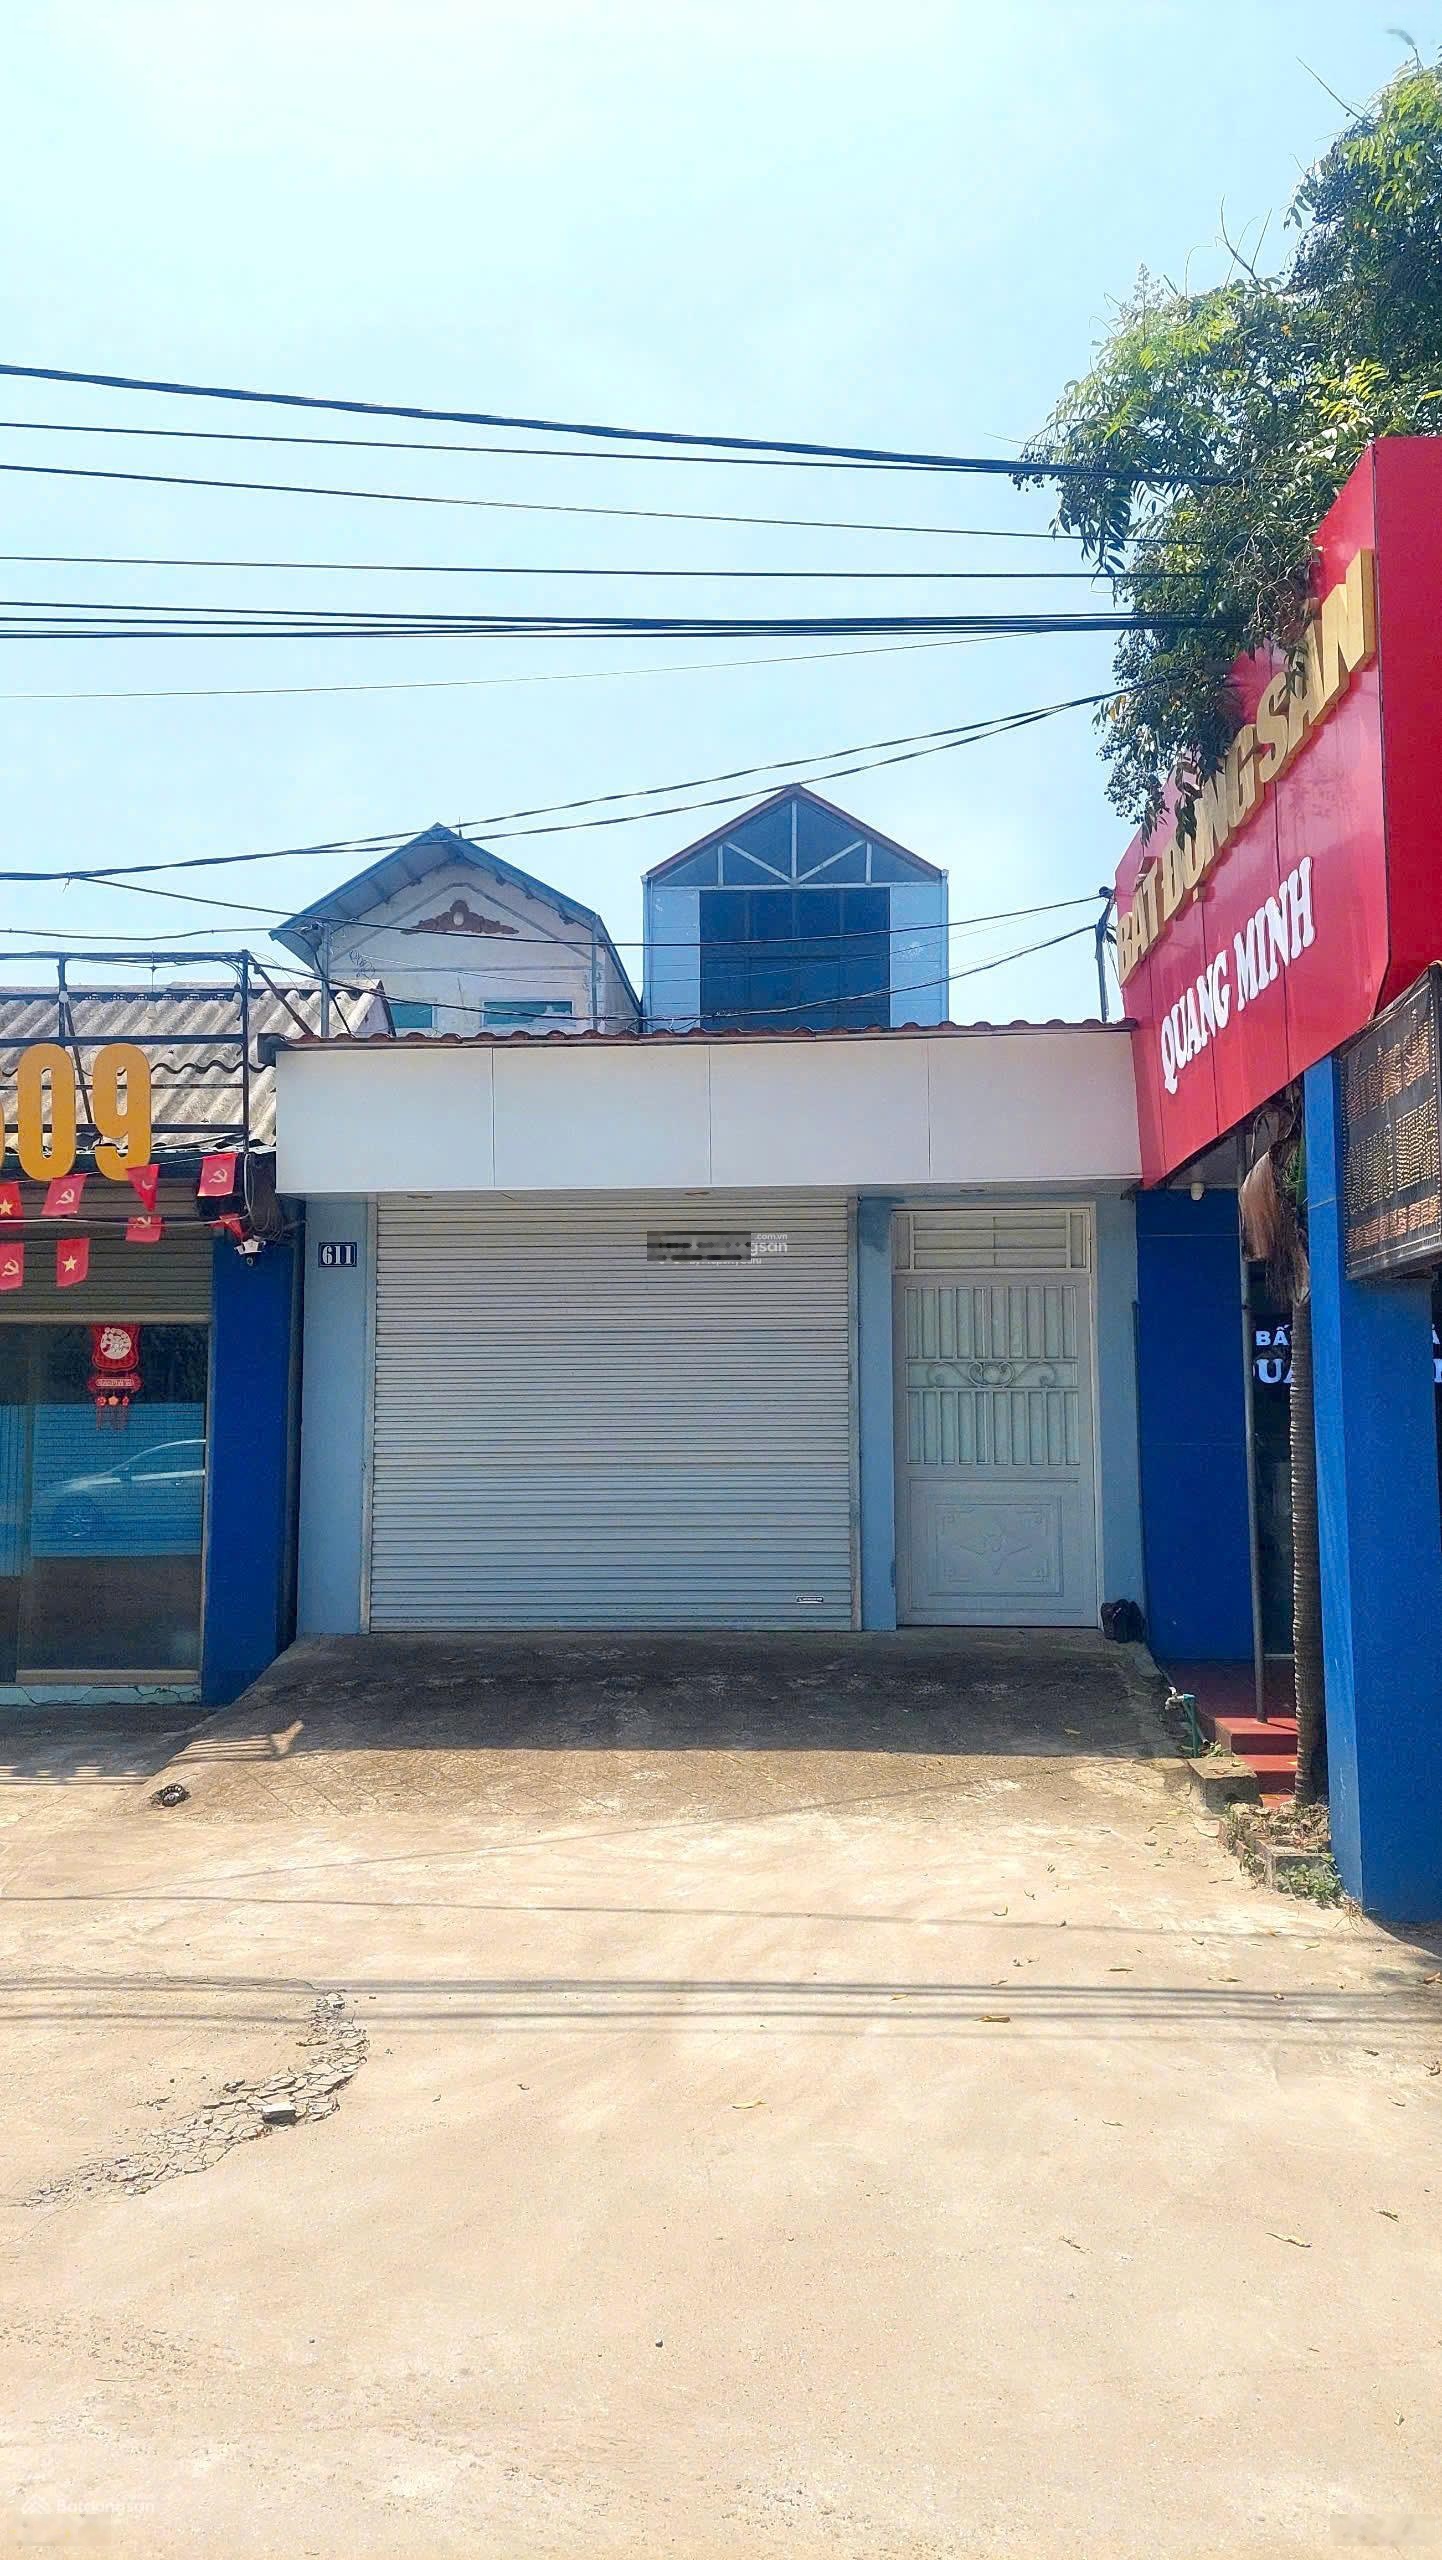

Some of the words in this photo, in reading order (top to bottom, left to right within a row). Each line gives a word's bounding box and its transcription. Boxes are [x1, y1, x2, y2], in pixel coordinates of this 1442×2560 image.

[1161, 949, 1231, 1094] QUANG
[1234, 856, 1316, 1011] MINH
[0, 1042, 152, 1181] 09
[322, 1245, 352, 1265] 611
[1255, 1323, 1293, 1346] BẤ
